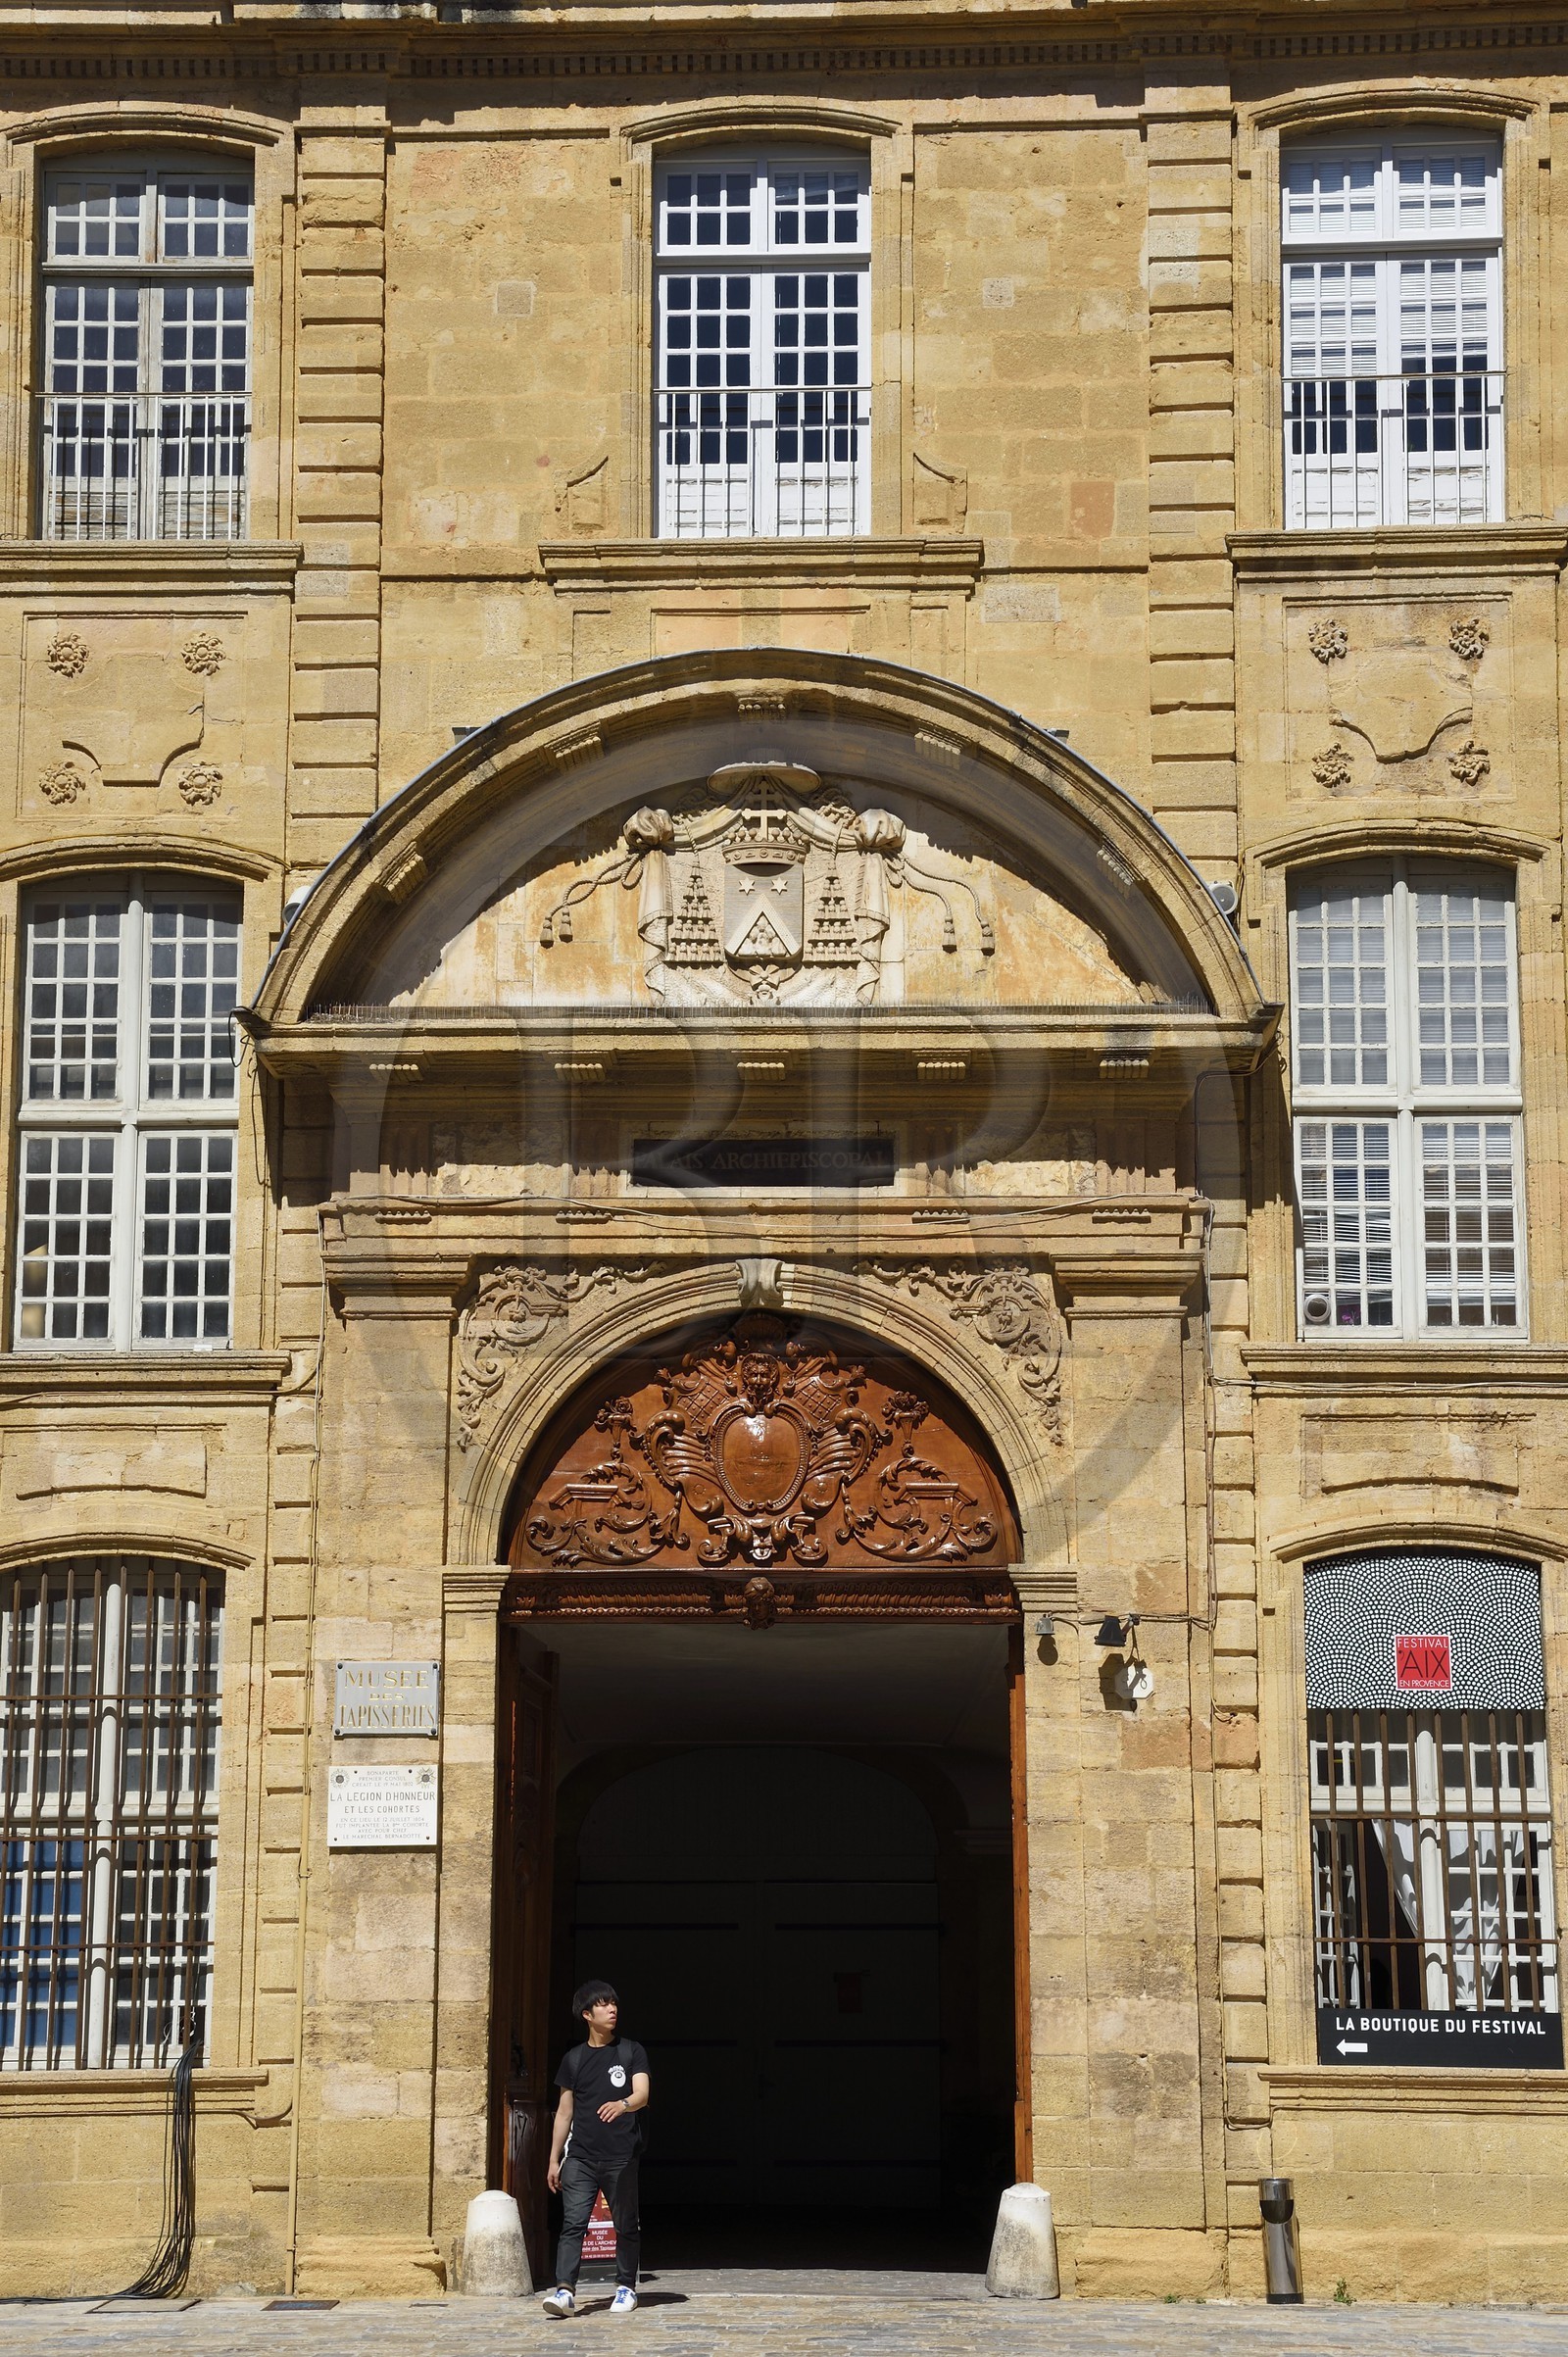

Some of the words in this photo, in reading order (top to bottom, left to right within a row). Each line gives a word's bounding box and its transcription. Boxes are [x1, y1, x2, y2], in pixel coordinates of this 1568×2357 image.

[635, 1152, 704, 1169] PALAIS
[1396, 1638, 1448, 1648] FESTIVAL
[1398, 1679, 1410, 1688] EN
[1411, 1679, 1449, 1688] PROVENCE
[368, 1693, 404, 1701] DES
[339, 1704, 435, 1729] TAPISSERIES
[330, 1792, 343, 1801] LA
[1336, 2017, 1355, 2031] LA
[1360, 2017, 1440, 2034] BOUTIQUE
[1445, 2019, 1466, 2034] DU
[1472, 2020, 1546, 2036] FESTIVAL
